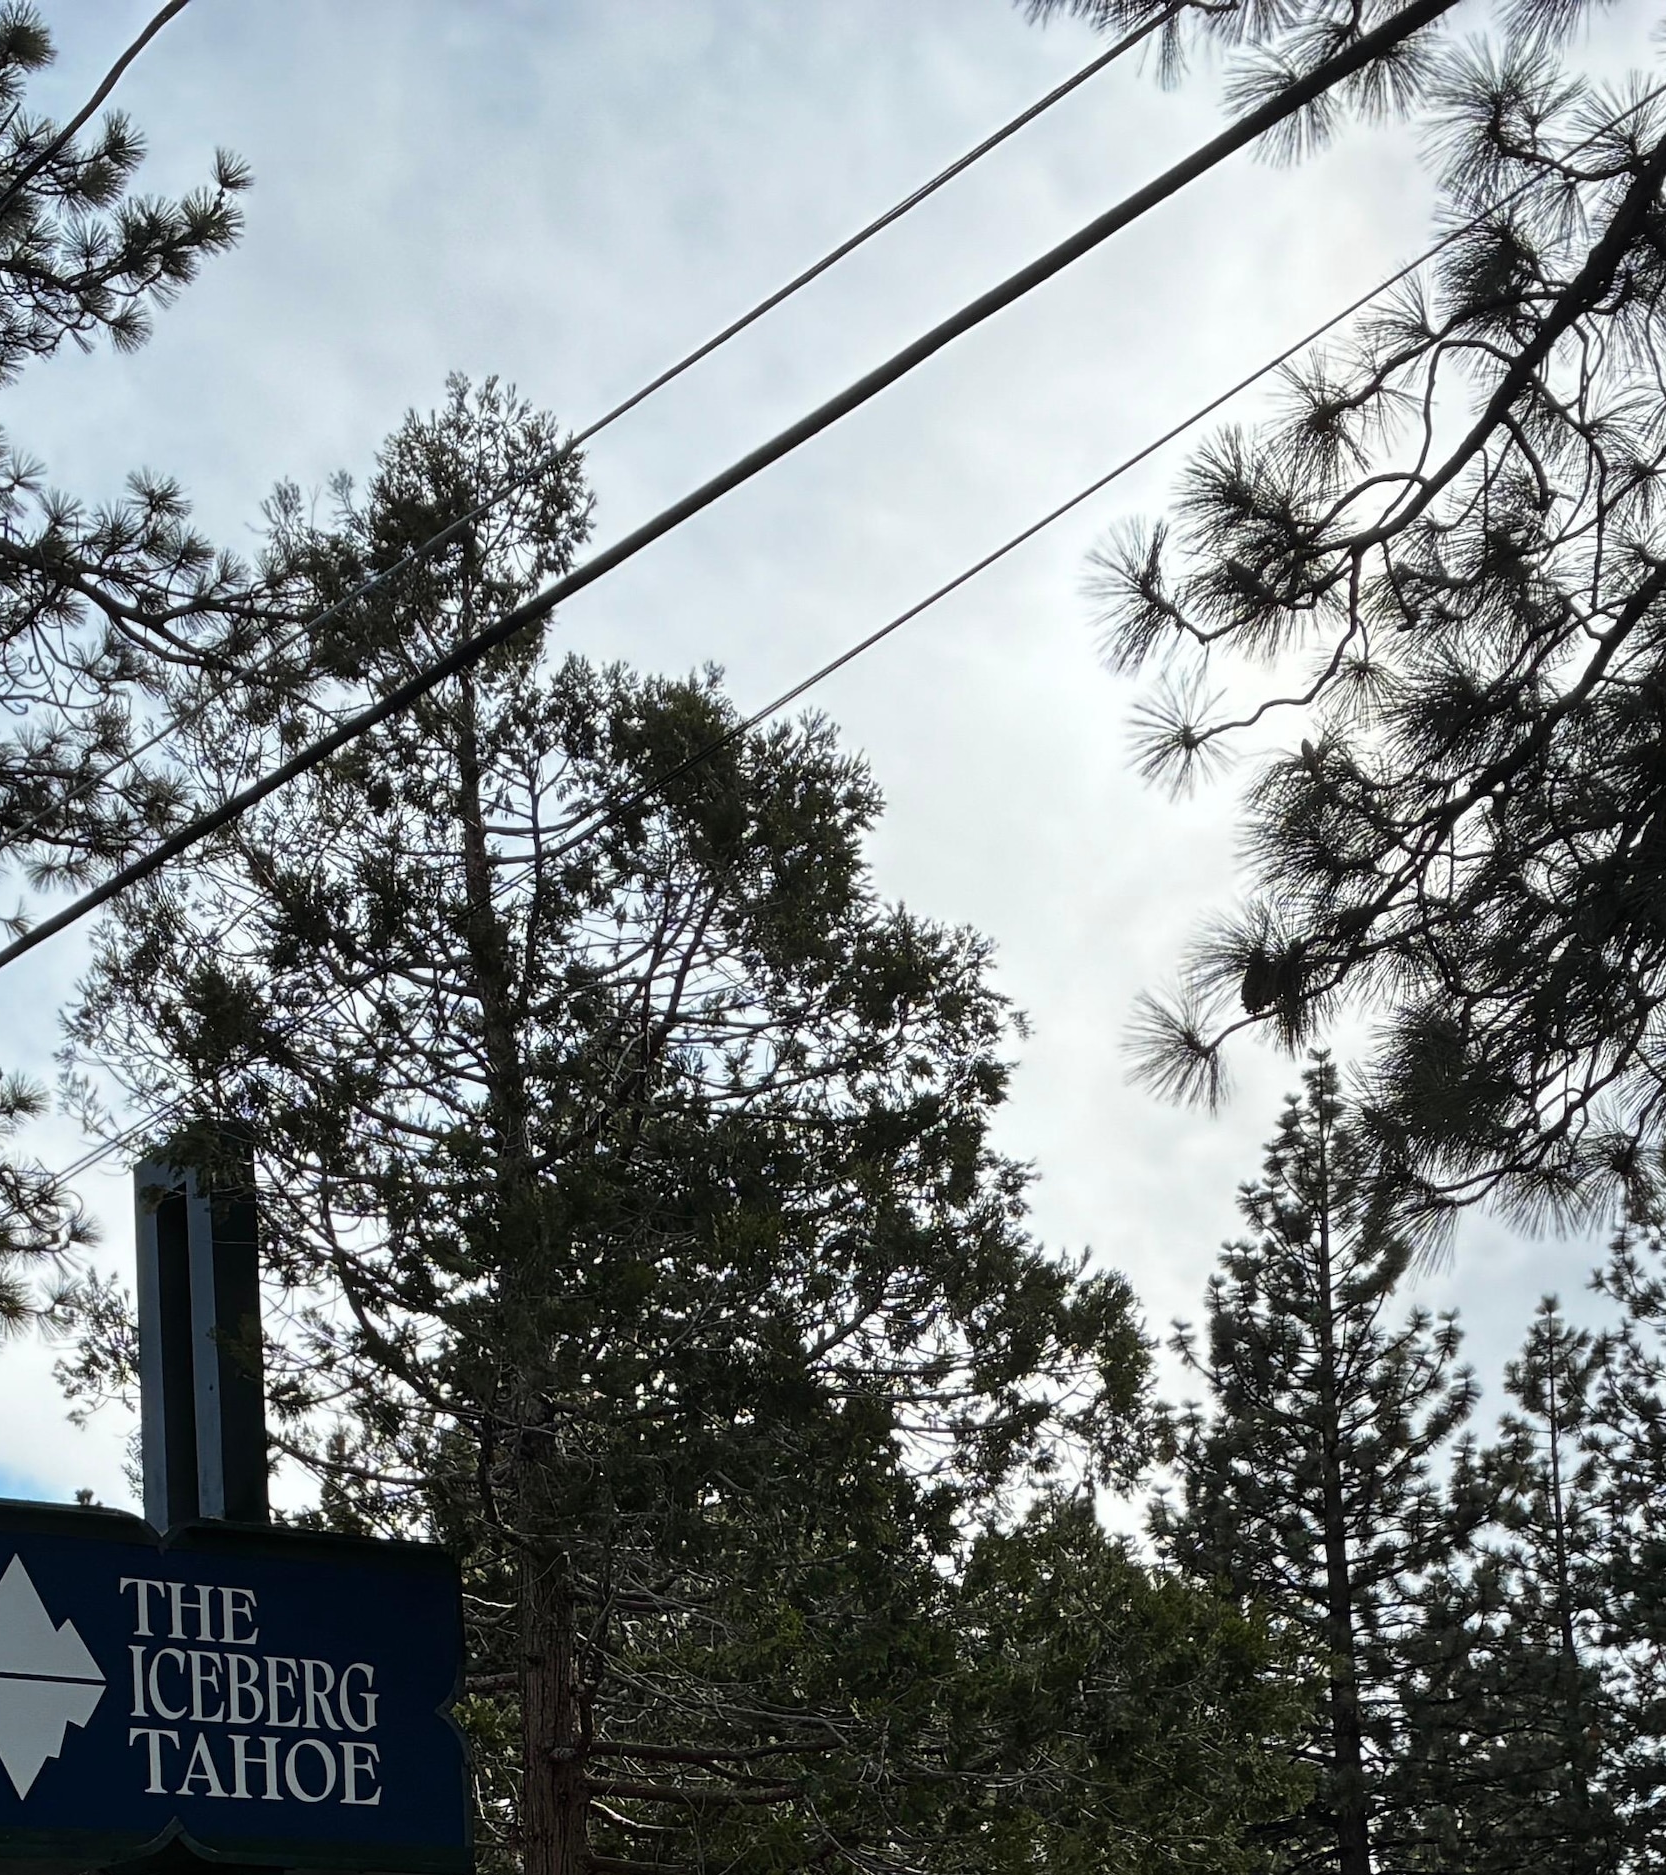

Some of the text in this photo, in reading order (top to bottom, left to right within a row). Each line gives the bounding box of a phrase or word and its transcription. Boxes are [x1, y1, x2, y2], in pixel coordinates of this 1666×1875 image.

[119, 1577, 259, 1645] THE
[128, 1645, 379, 1733] ICEBERG
[129, 1729, 383, 1806] TAHOE
